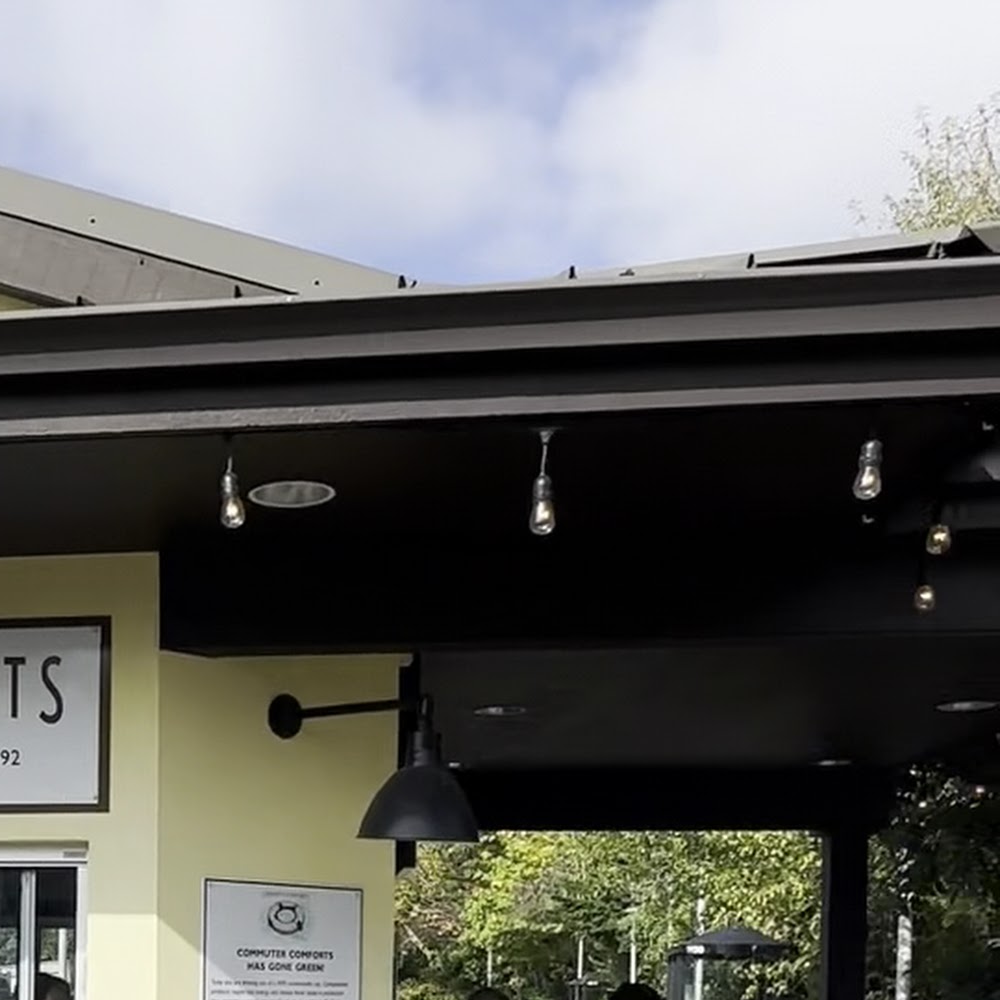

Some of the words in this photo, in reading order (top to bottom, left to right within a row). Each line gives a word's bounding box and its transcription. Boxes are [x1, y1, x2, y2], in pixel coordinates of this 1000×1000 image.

[236, 948, 287, 959] COMMUTER
[288, 949, 334, 960] COMFORTS
[246, 962, 266, 972] HAS
[267, 962, 293, 972] GONE
